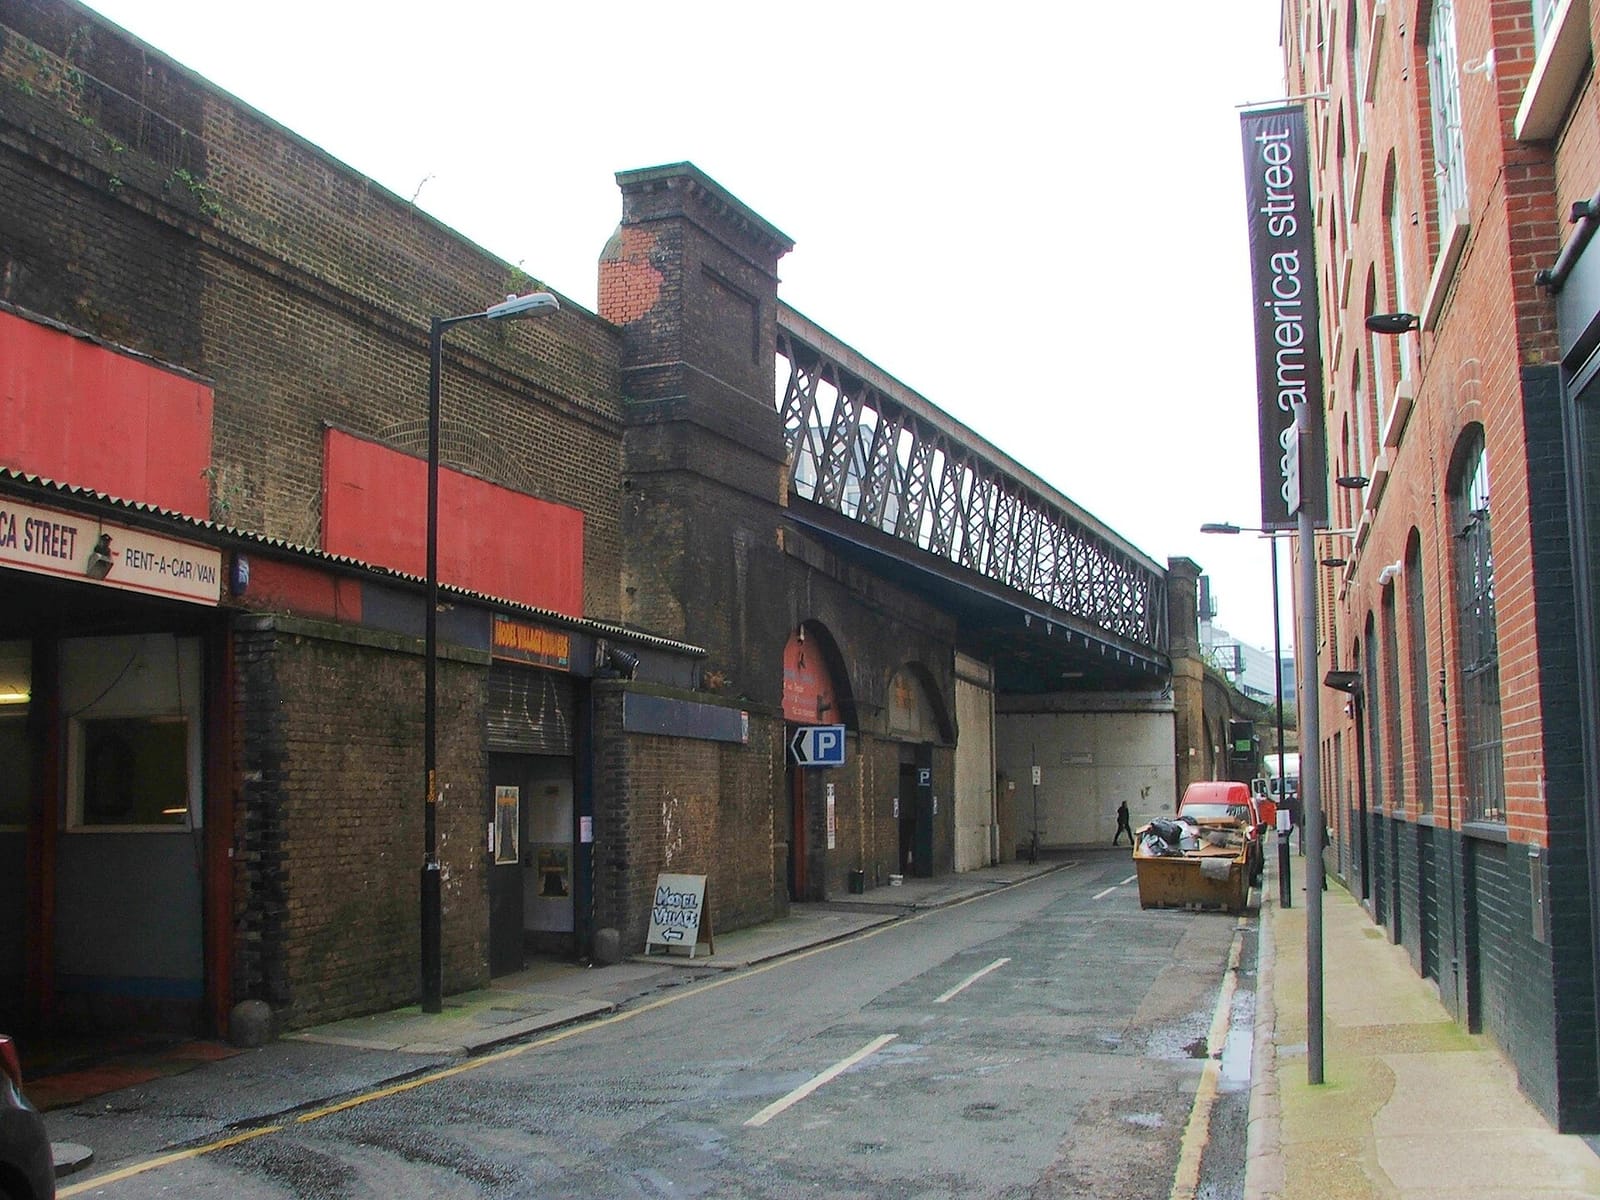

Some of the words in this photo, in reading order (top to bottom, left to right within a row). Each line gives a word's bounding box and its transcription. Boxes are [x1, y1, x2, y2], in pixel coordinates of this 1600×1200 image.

[1256, 129, 1298, 238] street
[1265, 249, 1306, 412] america
[24, 516, 78, 561] STREET
[818, 732, 836, 759] P
[920, 771, 930, 785] P
[656, 885, 698, 910] MODEL
